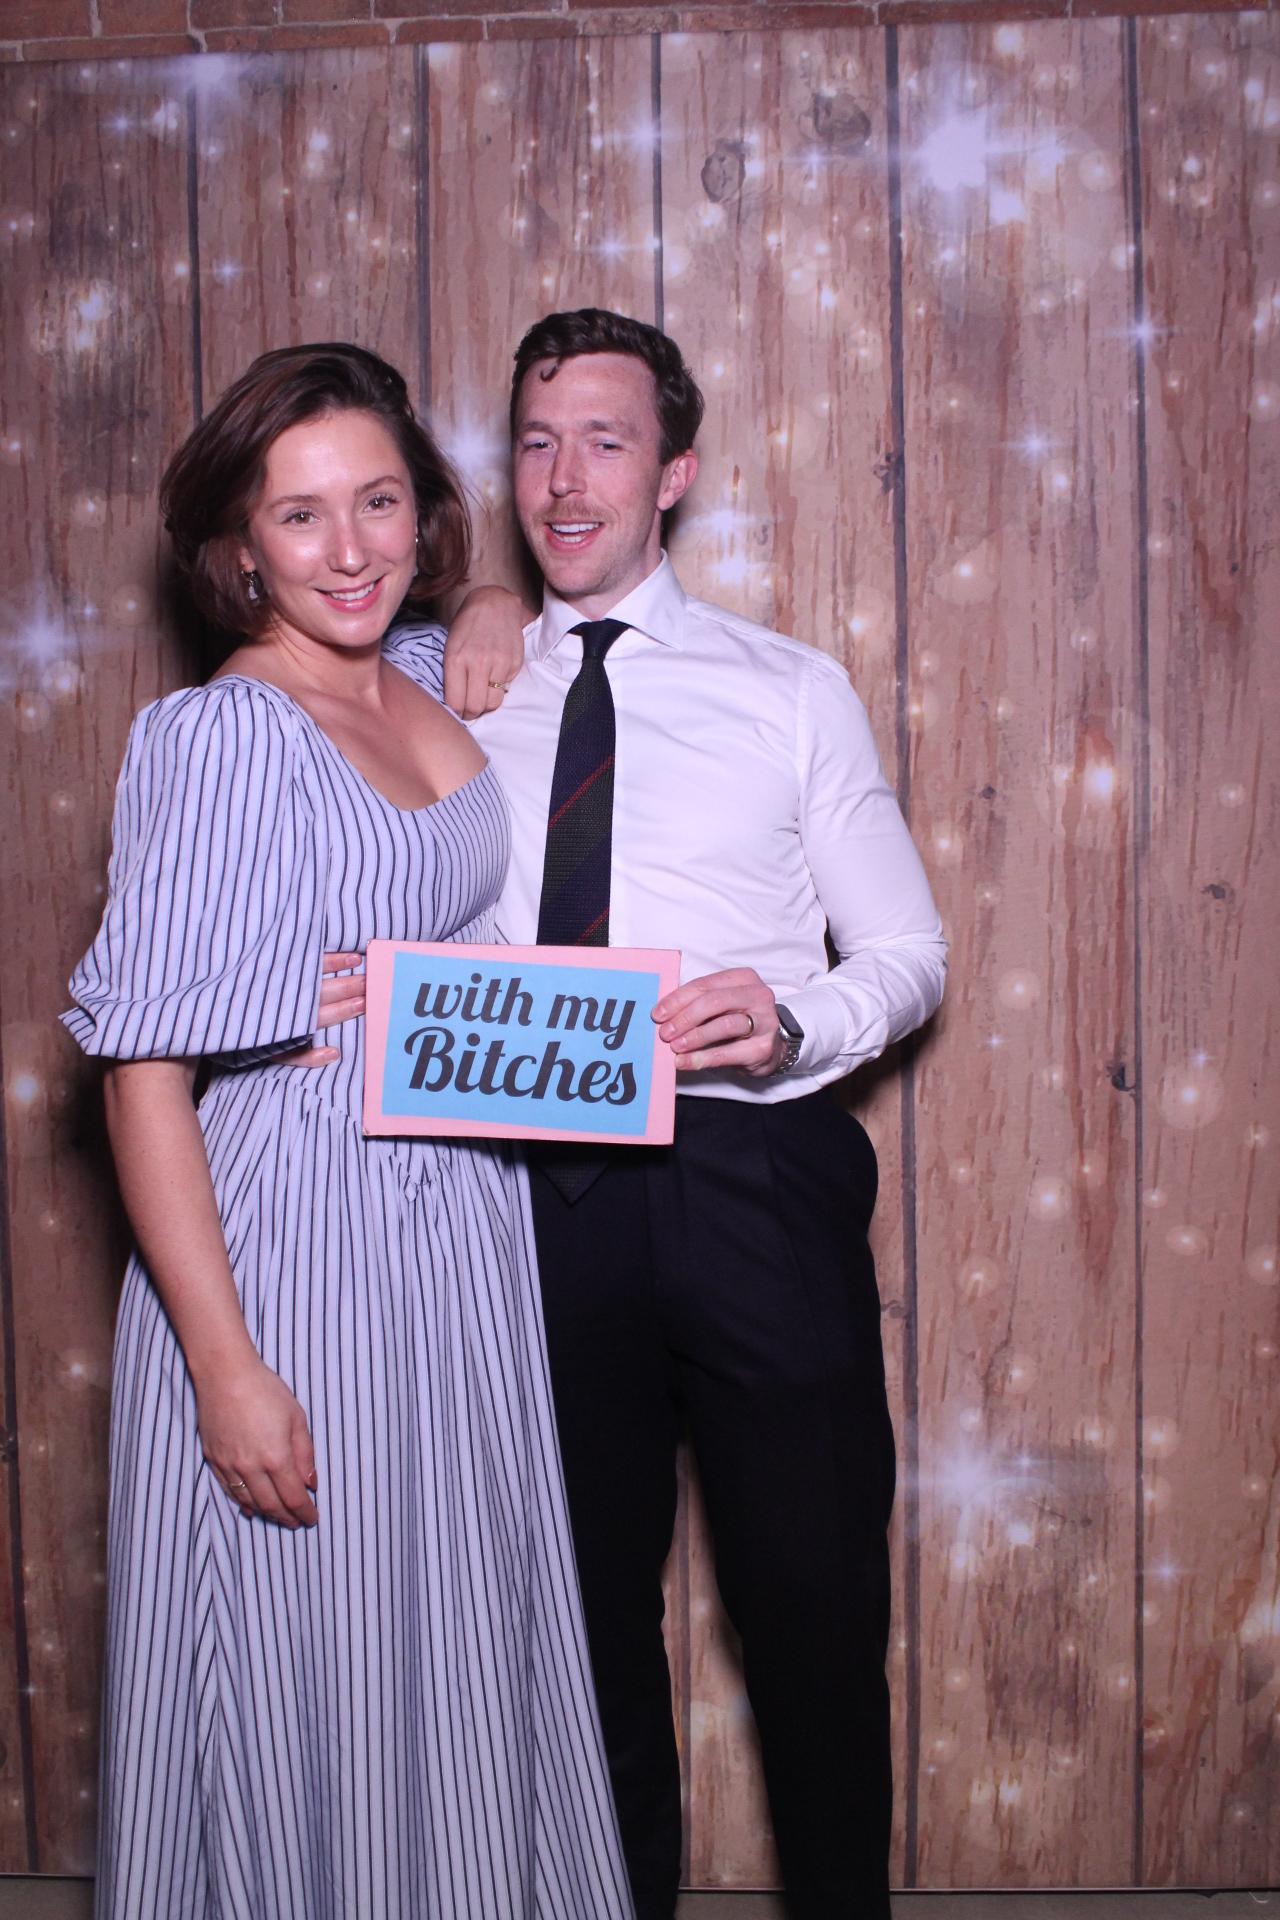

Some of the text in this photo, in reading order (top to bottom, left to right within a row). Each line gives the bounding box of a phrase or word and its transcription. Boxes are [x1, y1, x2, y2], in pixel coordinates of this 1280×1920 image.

[413, 973, 636, 1051] with my
[404, 1026, 637, 1106] Bitches
